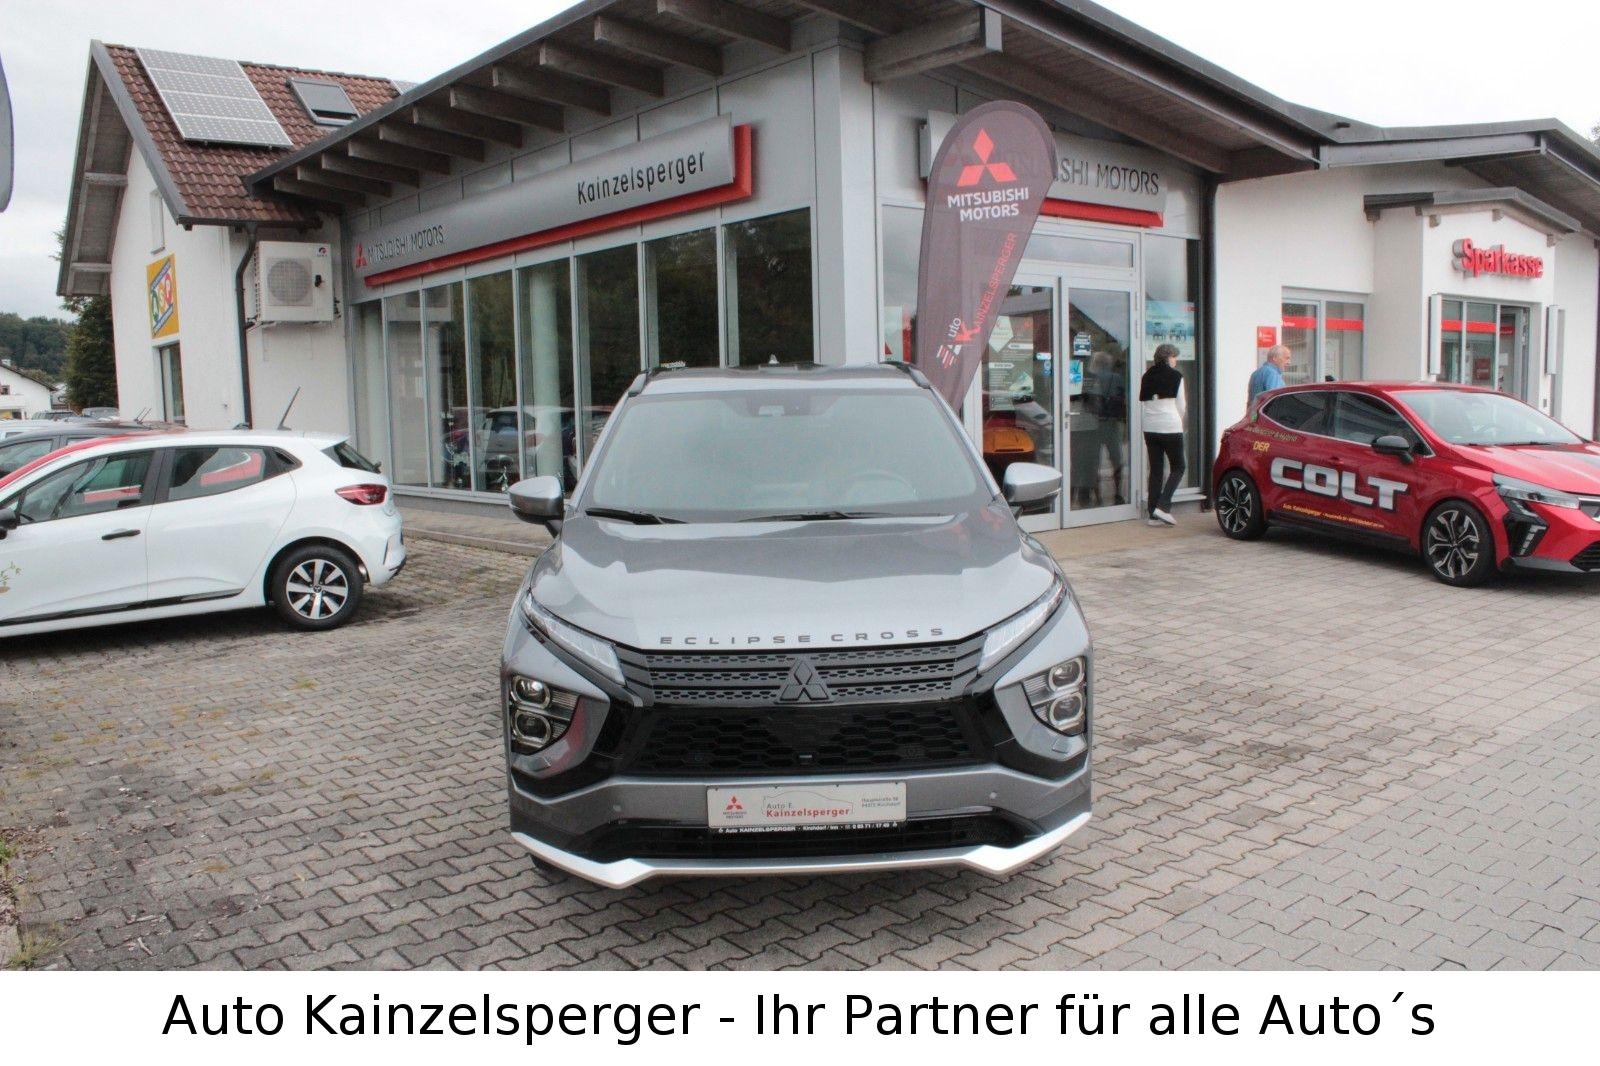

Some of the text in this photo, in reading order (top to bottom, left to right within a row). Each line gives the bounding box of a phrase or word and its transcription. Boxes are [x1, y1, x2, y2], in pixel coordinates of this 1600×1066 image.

[576, 150, 705, 206] Kainzelsperger
[1096, 163, 1160, 196] MOTORS
[947, 186, 1030, 209] MITSUBISHI
[960, 202, 1020, 223] MOTORS
[367, 224, 445, 263] MITSUBISHI MOTORS
[1460, 238, 1544, 279] Sparkasse
[1252, 440, 1270, 453] DER
[1270, 456, 1409, 511] COLT
[659, 627, 943, 646] ECLIPSE CROSS
[766, 802, 786, 810] Auto
[766, 808, 850, 820] Kainzelsperger
